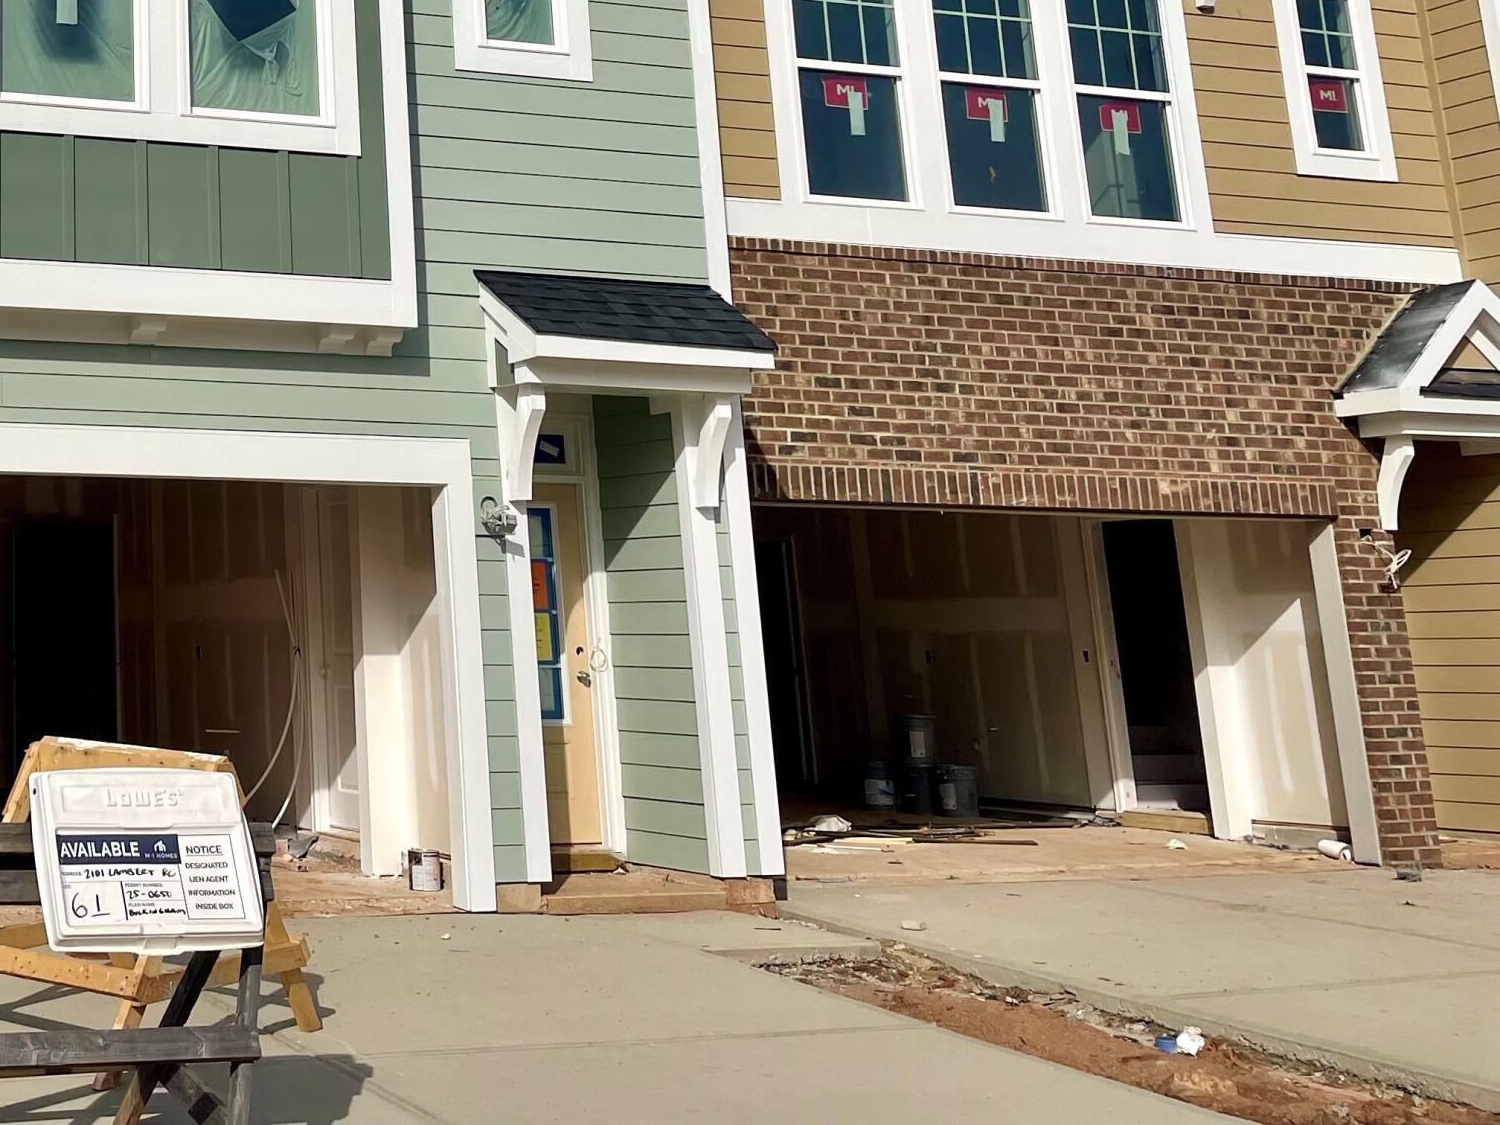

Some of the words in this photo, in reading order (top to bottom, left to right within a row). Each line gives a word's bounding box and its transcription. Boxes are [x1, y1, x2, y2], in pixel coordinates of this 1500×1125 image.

[60, 841, 141, 858] AVAILABLE
[185, 845, 222, 854] NOTICE
[185, 861, 229, 869] DESIGNATED
[205, 875, 229, 883] AGENT
